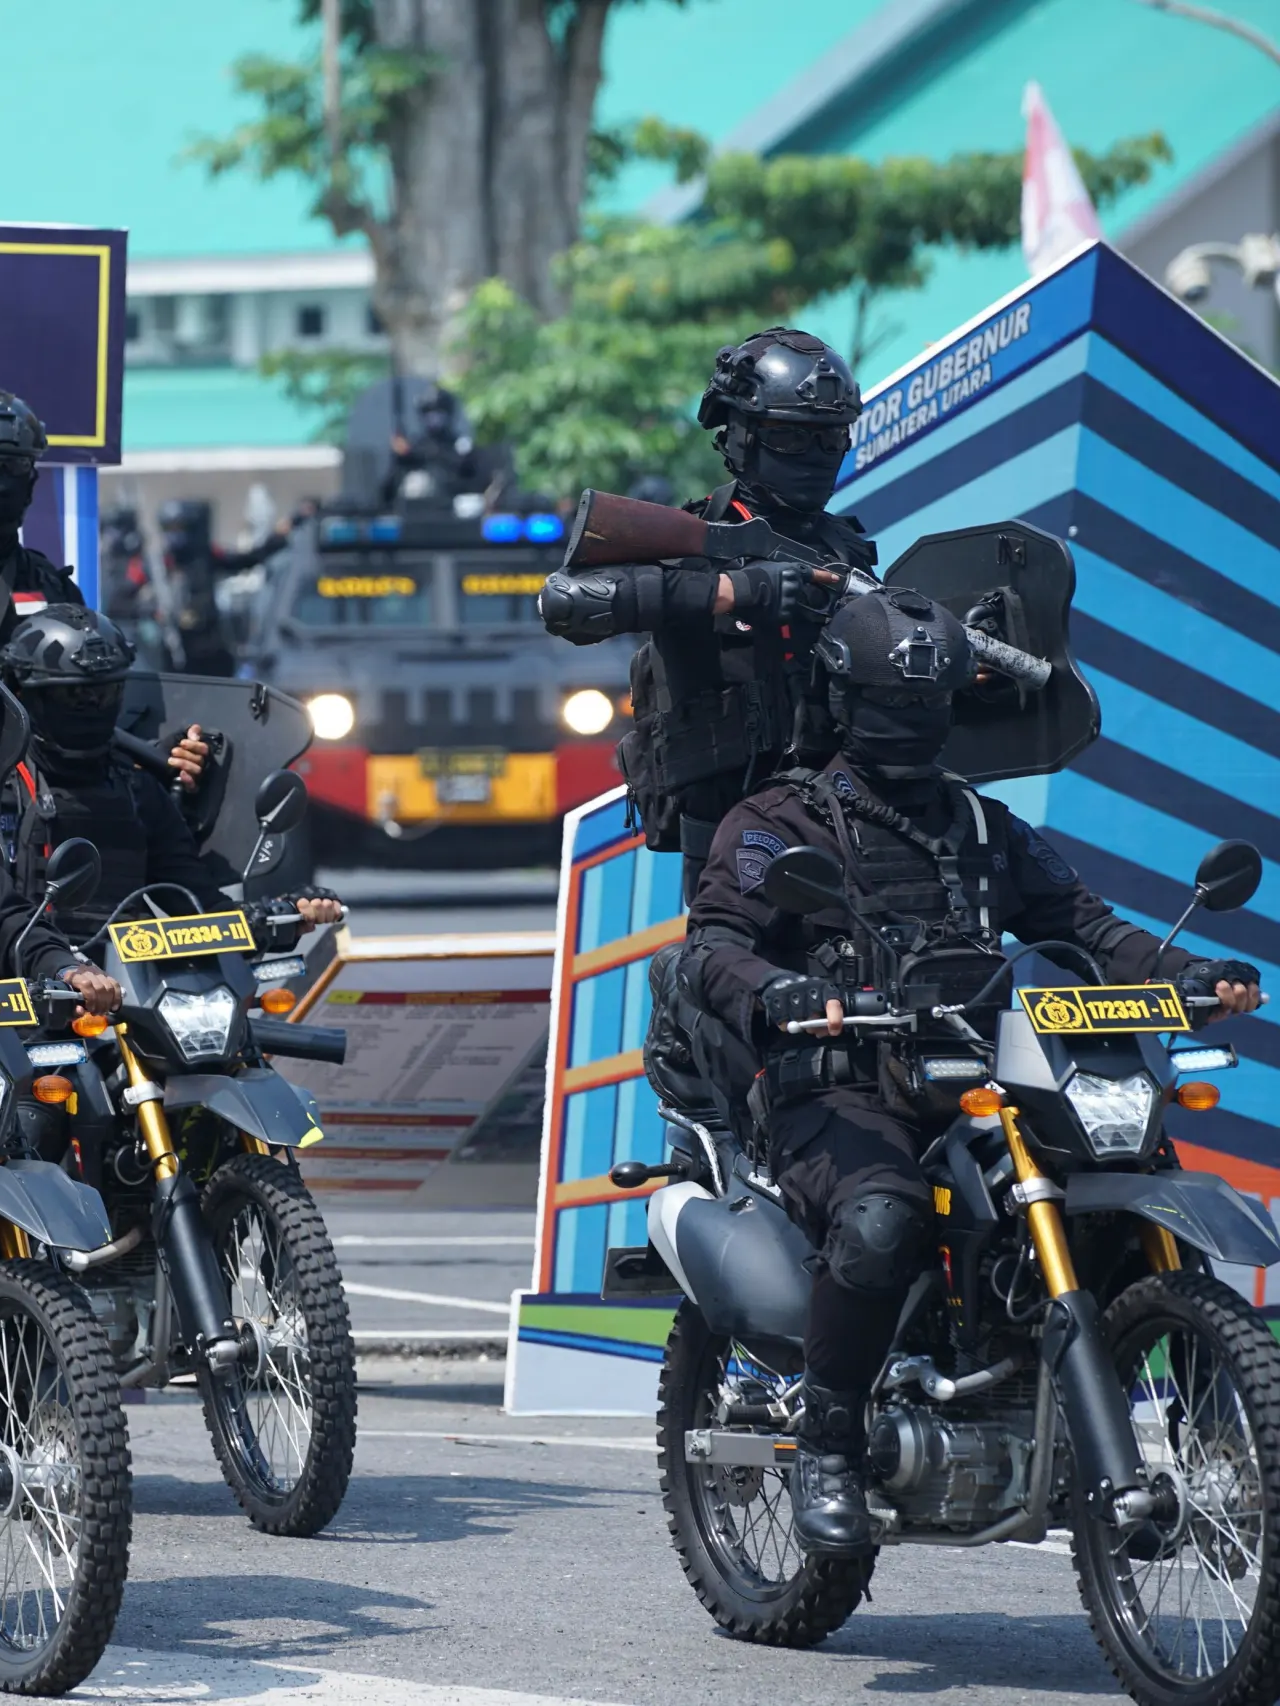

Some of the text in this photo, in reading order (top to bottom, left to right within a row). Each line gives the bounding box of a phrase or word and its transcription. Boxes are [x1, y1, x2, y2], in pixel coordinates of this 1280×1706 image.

[907, 302, 1031, 409] GUBERNUR
[855, 362, 992, 470] SUMATERA UTARA
[746, 833, 787, 854] PELOPO
